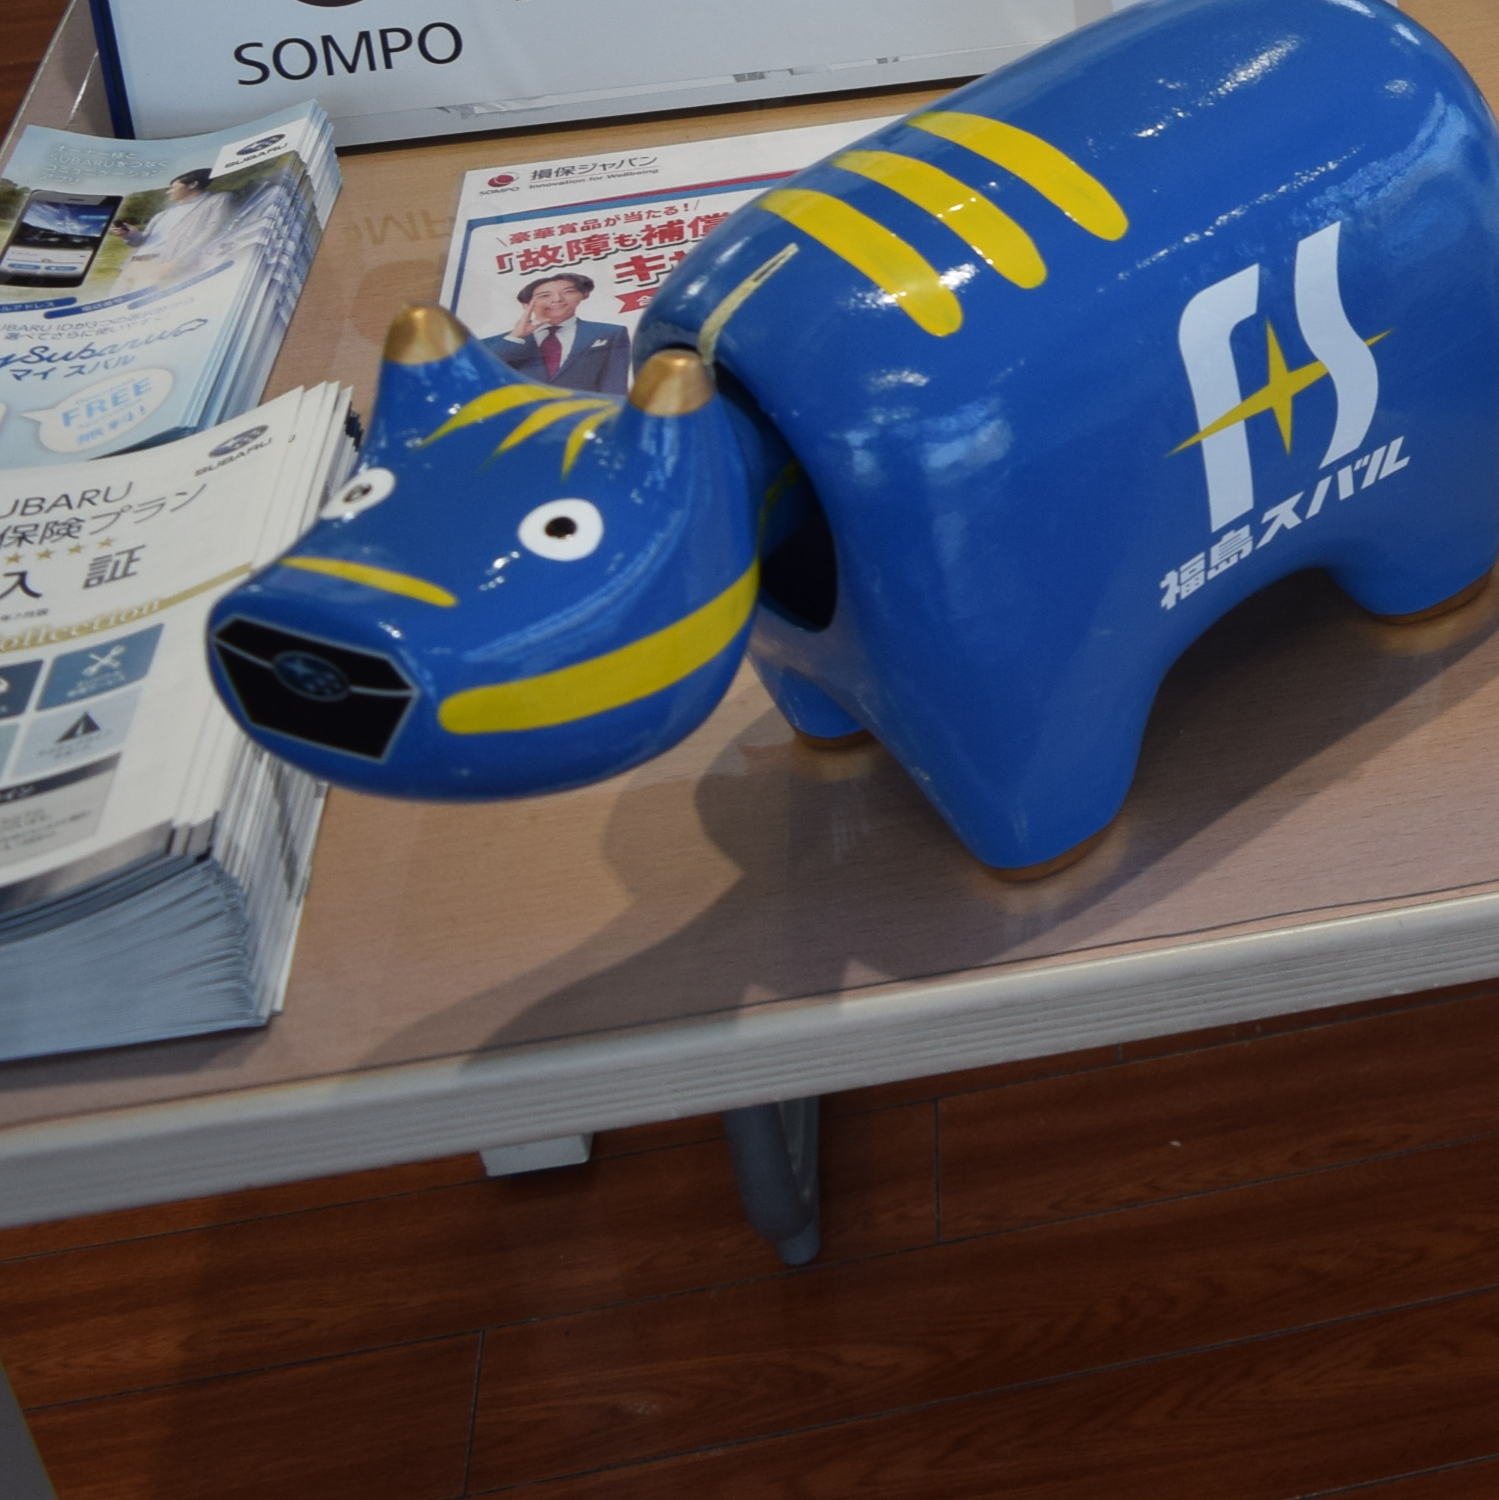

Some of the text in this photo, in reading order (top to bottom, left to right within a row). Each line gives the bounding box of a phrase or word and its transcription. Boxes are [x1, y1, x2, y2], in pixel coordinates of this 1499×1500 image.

[234, 21, 463, 86] SOMPO
[225, 143, 289, 169] SUBARU
[529, 155, 658, 181] 損保ジャパン
[479, 186, 520, 196] SOMPO
[529, 177, 586, 190] Innovation
[606, 167, 660, 181] Wellbeing
[62, 378, 152, 427] FREE
[195, 437, 273, 477] SUBARU
[0, 481, 133, 520] UBARU
[0, 483, 207, 549] 保険プラン
[1159, 436, 1411, 611] 福島スバル
